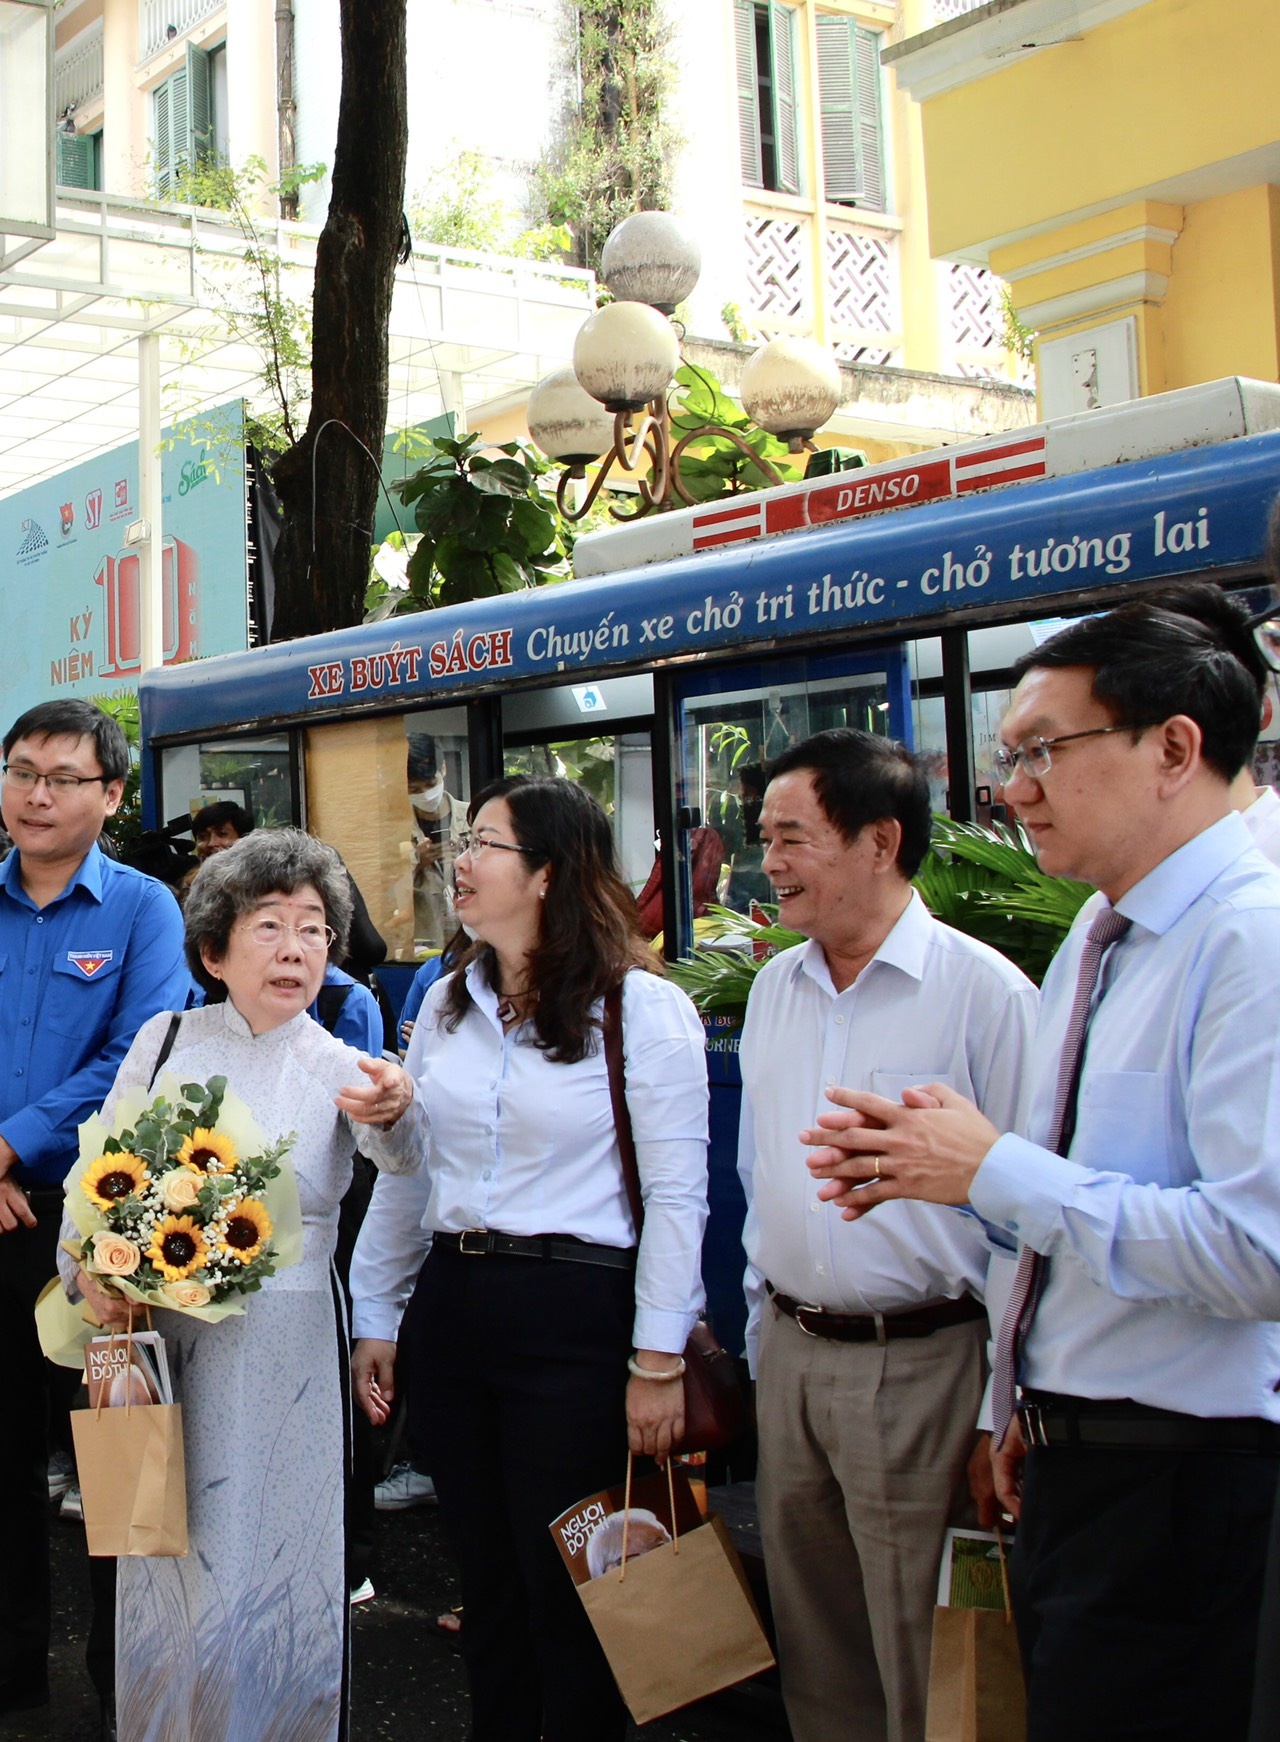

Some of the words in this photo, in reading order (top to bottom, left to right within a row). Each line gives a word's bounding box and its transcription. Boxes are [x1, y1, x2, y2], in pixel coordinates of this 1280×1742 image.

[84, 488, 103, 530] ST
[837, 474, 920, 512] DENSO
[526, 612, 630, 662] Chuyến
[638, 615, 674, 644] xe
[686, 590, 744, 635] chở
[756, 584, 795, 624] tri
[807, 570, 886, 616] thức
[920, 544, 993, 596] chở
[1008, 532, 1132, 582] tương
[1153, 507, 1211, 557] lai
[50, 647, 94, 689] NIỆM
[307, 660, 345, 700] XE
[349, 640, 423, 694] BUÝT
[428, 627, 514, 680] SÁCH
